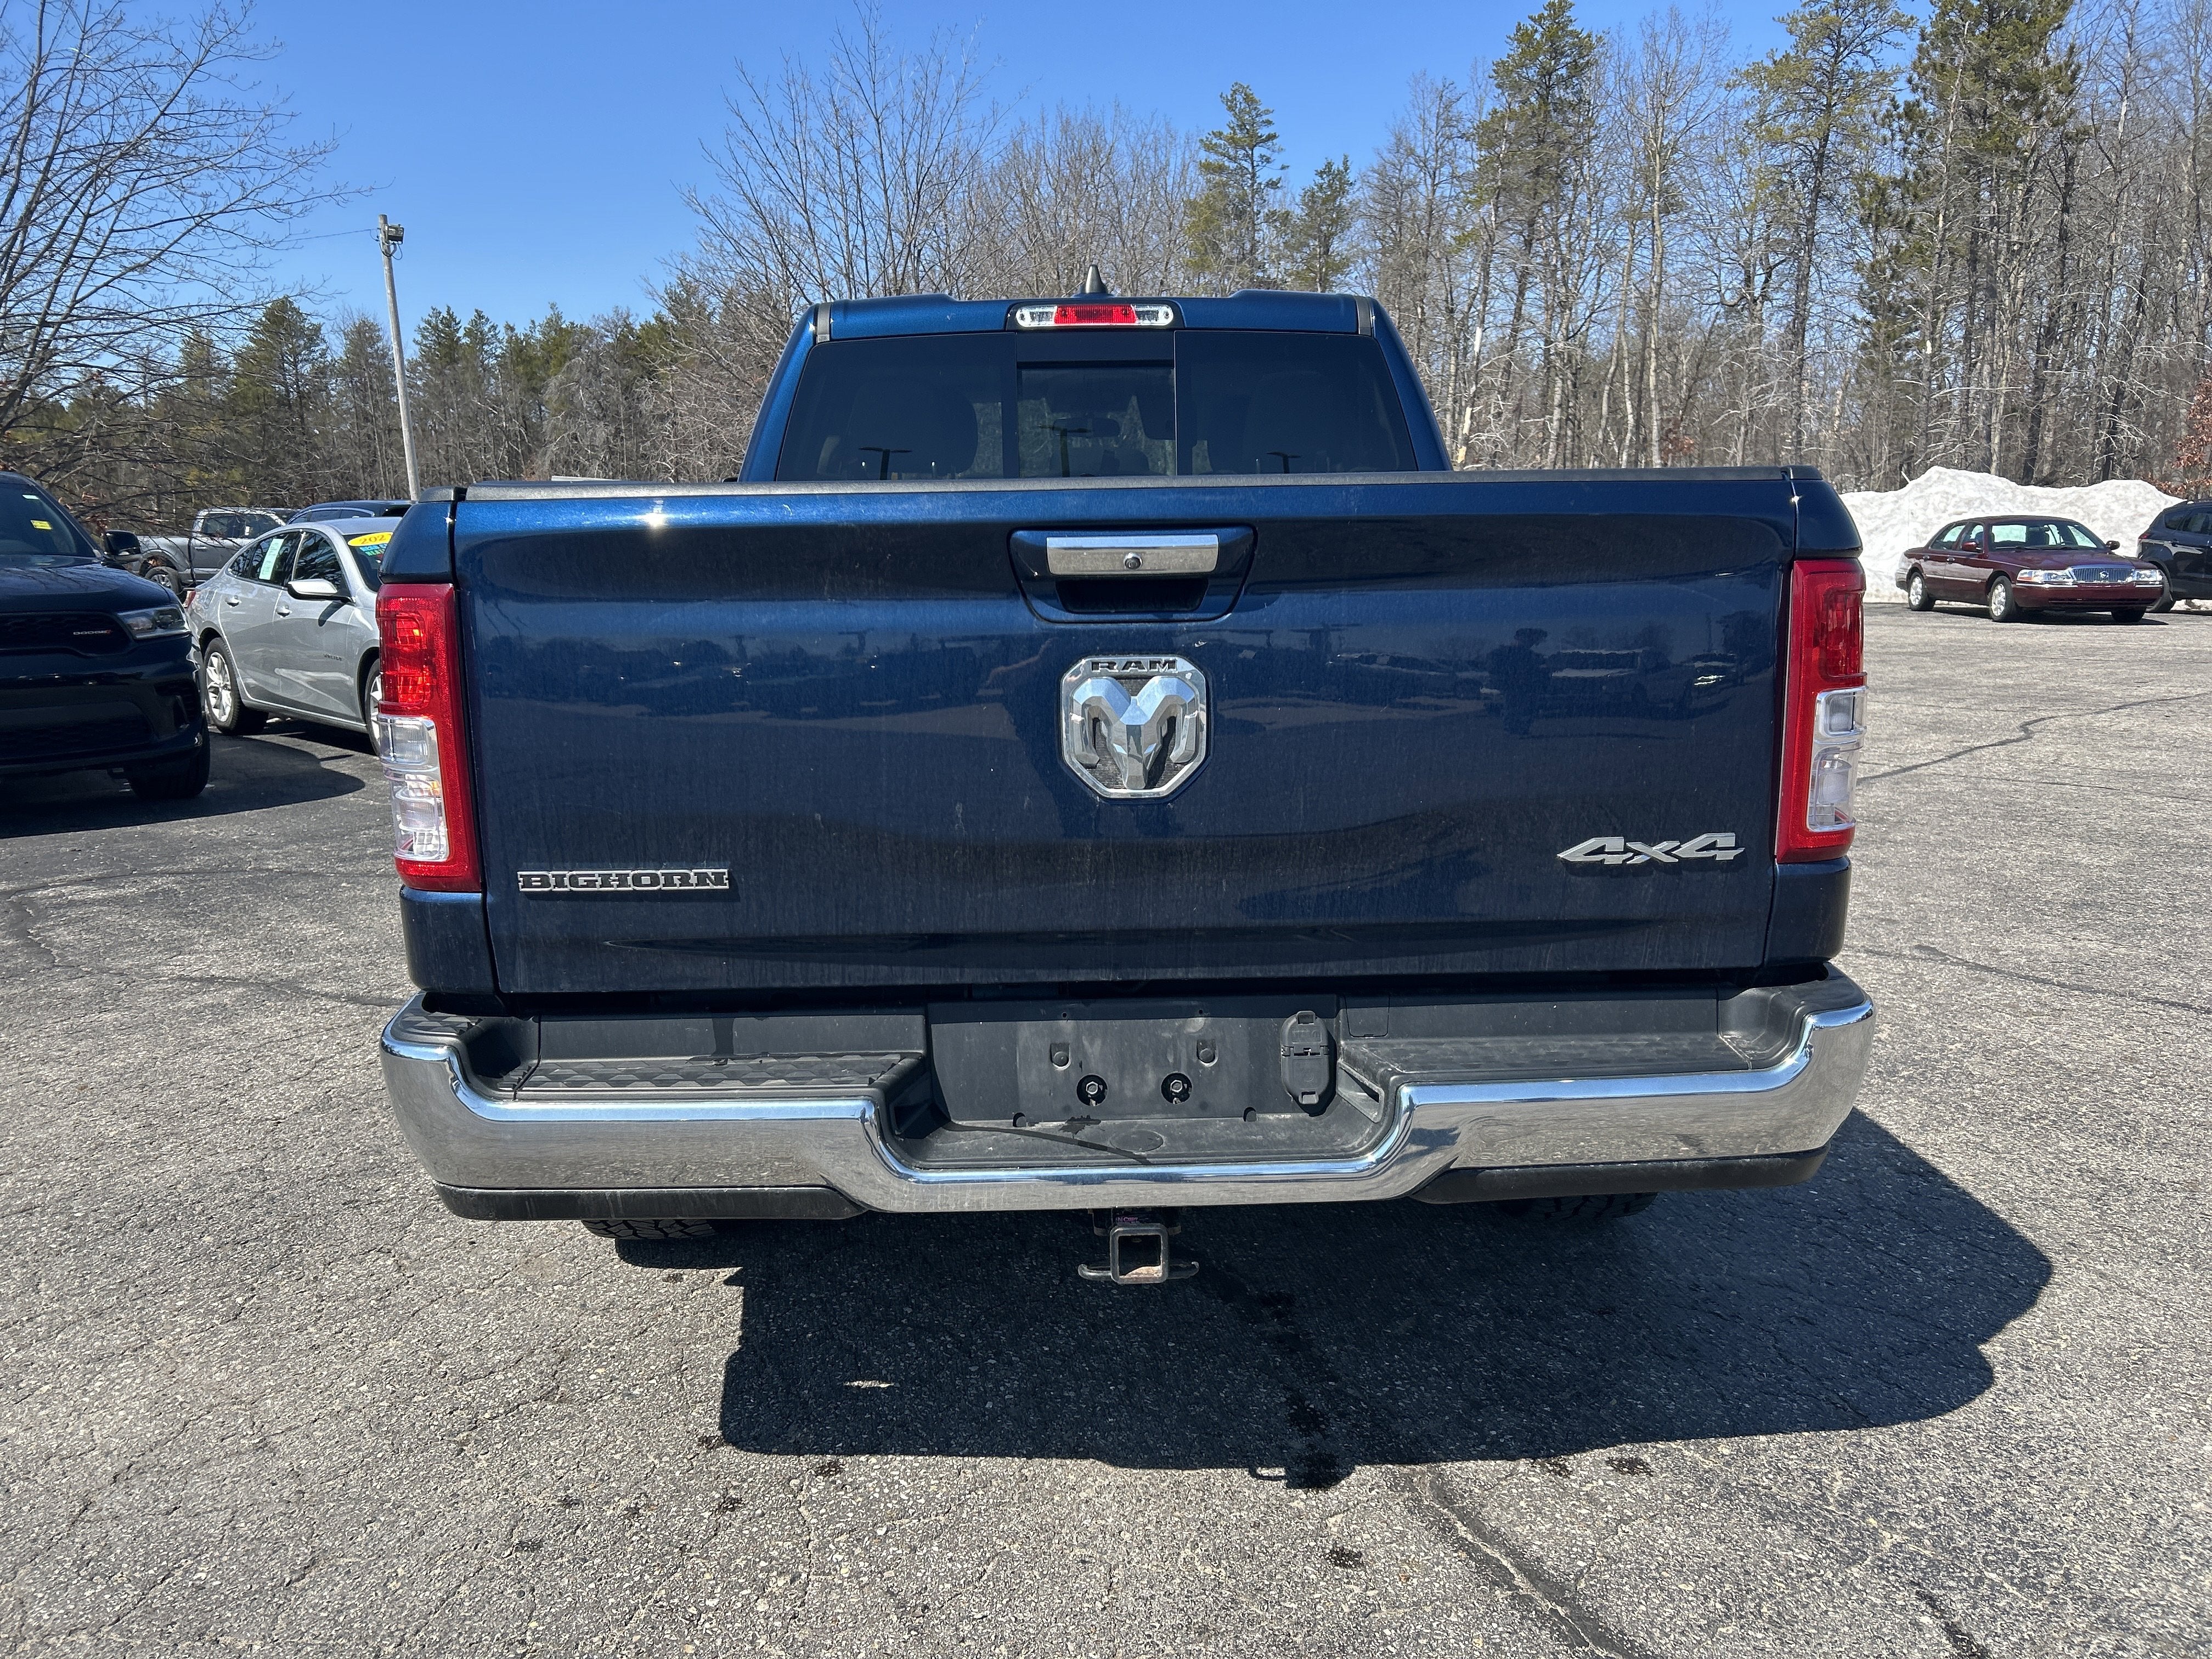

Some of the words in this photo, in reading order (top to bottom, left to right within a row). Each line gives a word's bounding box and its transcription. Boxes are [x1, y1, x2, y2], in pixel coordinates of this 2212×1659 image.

[359, 533, 393, 544] 202
[1091, 660, 1177, 673] RAM
[517, 869, 729, 891] BIGHORN
